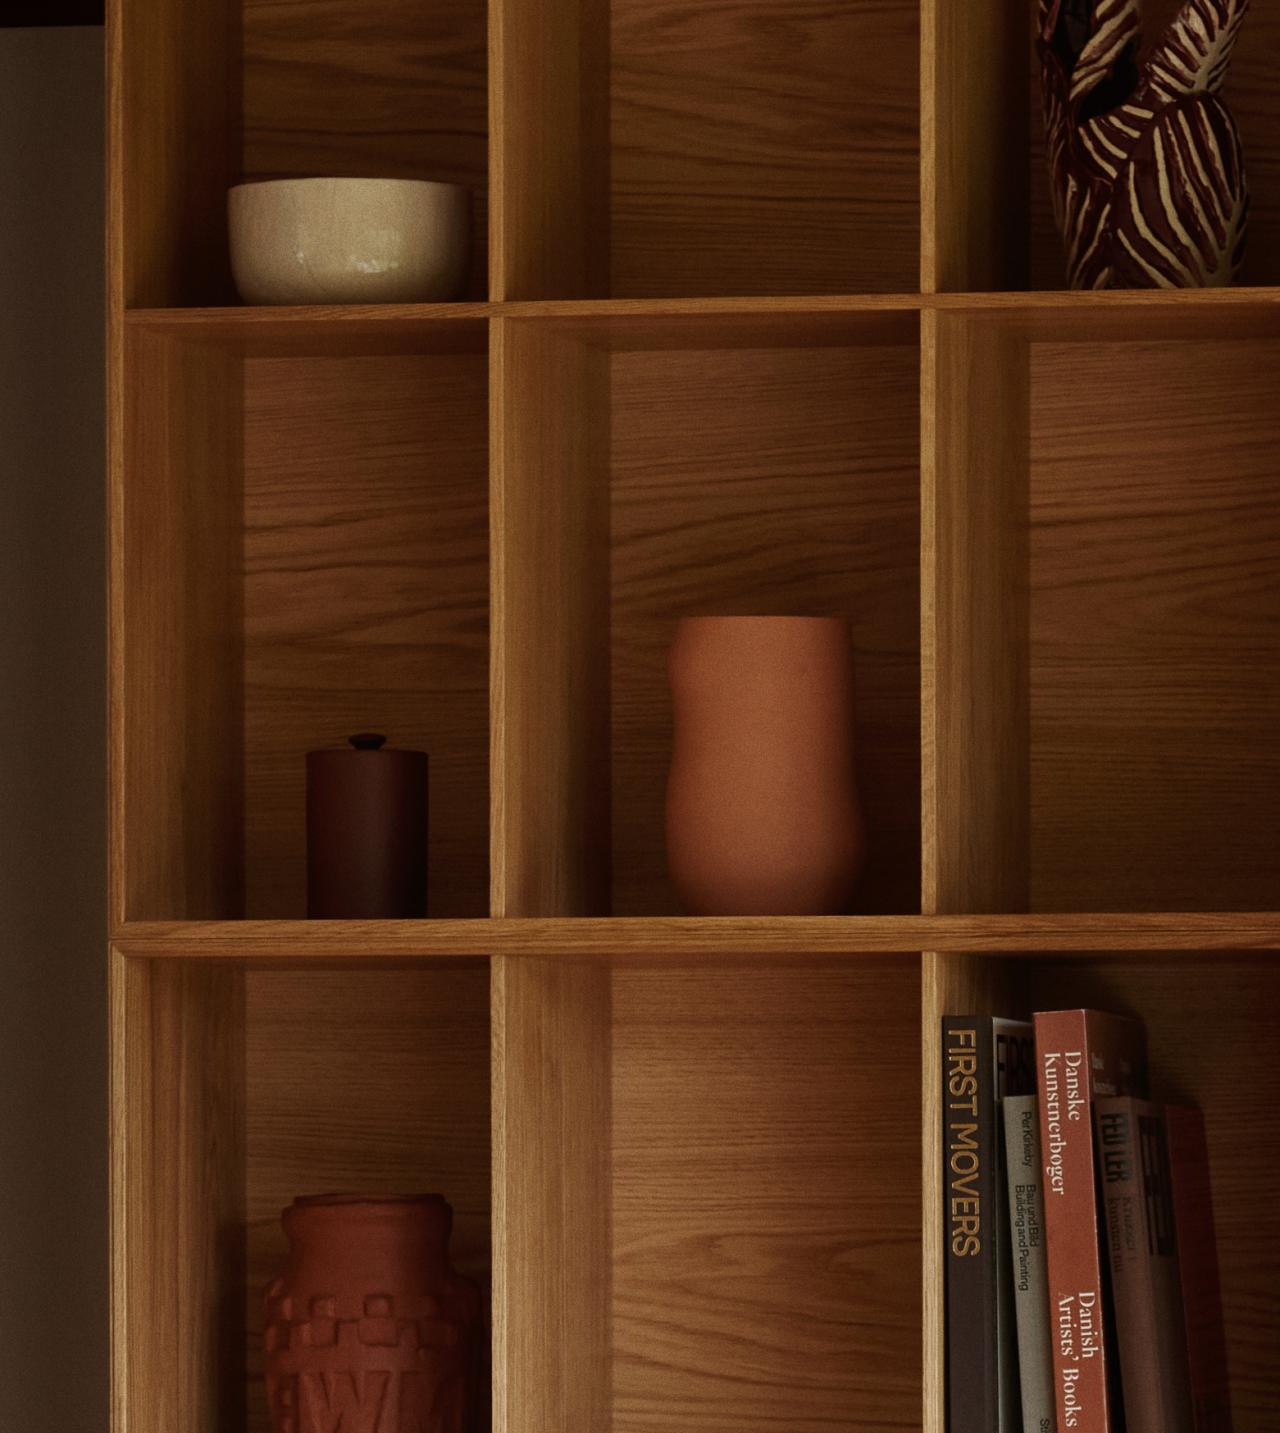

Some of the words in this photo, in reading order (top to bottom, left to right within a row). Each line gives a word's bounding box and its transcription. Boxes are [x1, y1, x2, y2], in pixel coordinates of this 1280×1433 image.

[948, 1029, 977, 1117] FIRST
[1065, 1051, 1085, 1121] Danske
[1022, 1112, 1032, 1128] Per
[1022, 1130, 1034, 1167] Kirkeby
[951, 1123, 980, 1257] MOVERS
[1015, 1185, 1026, 1227] Building
[1026, 1185, 1036, 1206] Bau
[1027, 1207, 1037, 1225] und
[1018, 1228, 1027, 1247] and
[1029, 1227, 1039, 1247] Bild
[1018, 1250, 1030, 1291] Painting
[1058, 1292, 1079, 1361] Artists’
[1078, 1292, 1099, 1358] Danish
[1062, 1368, 1082, 1427] Books
